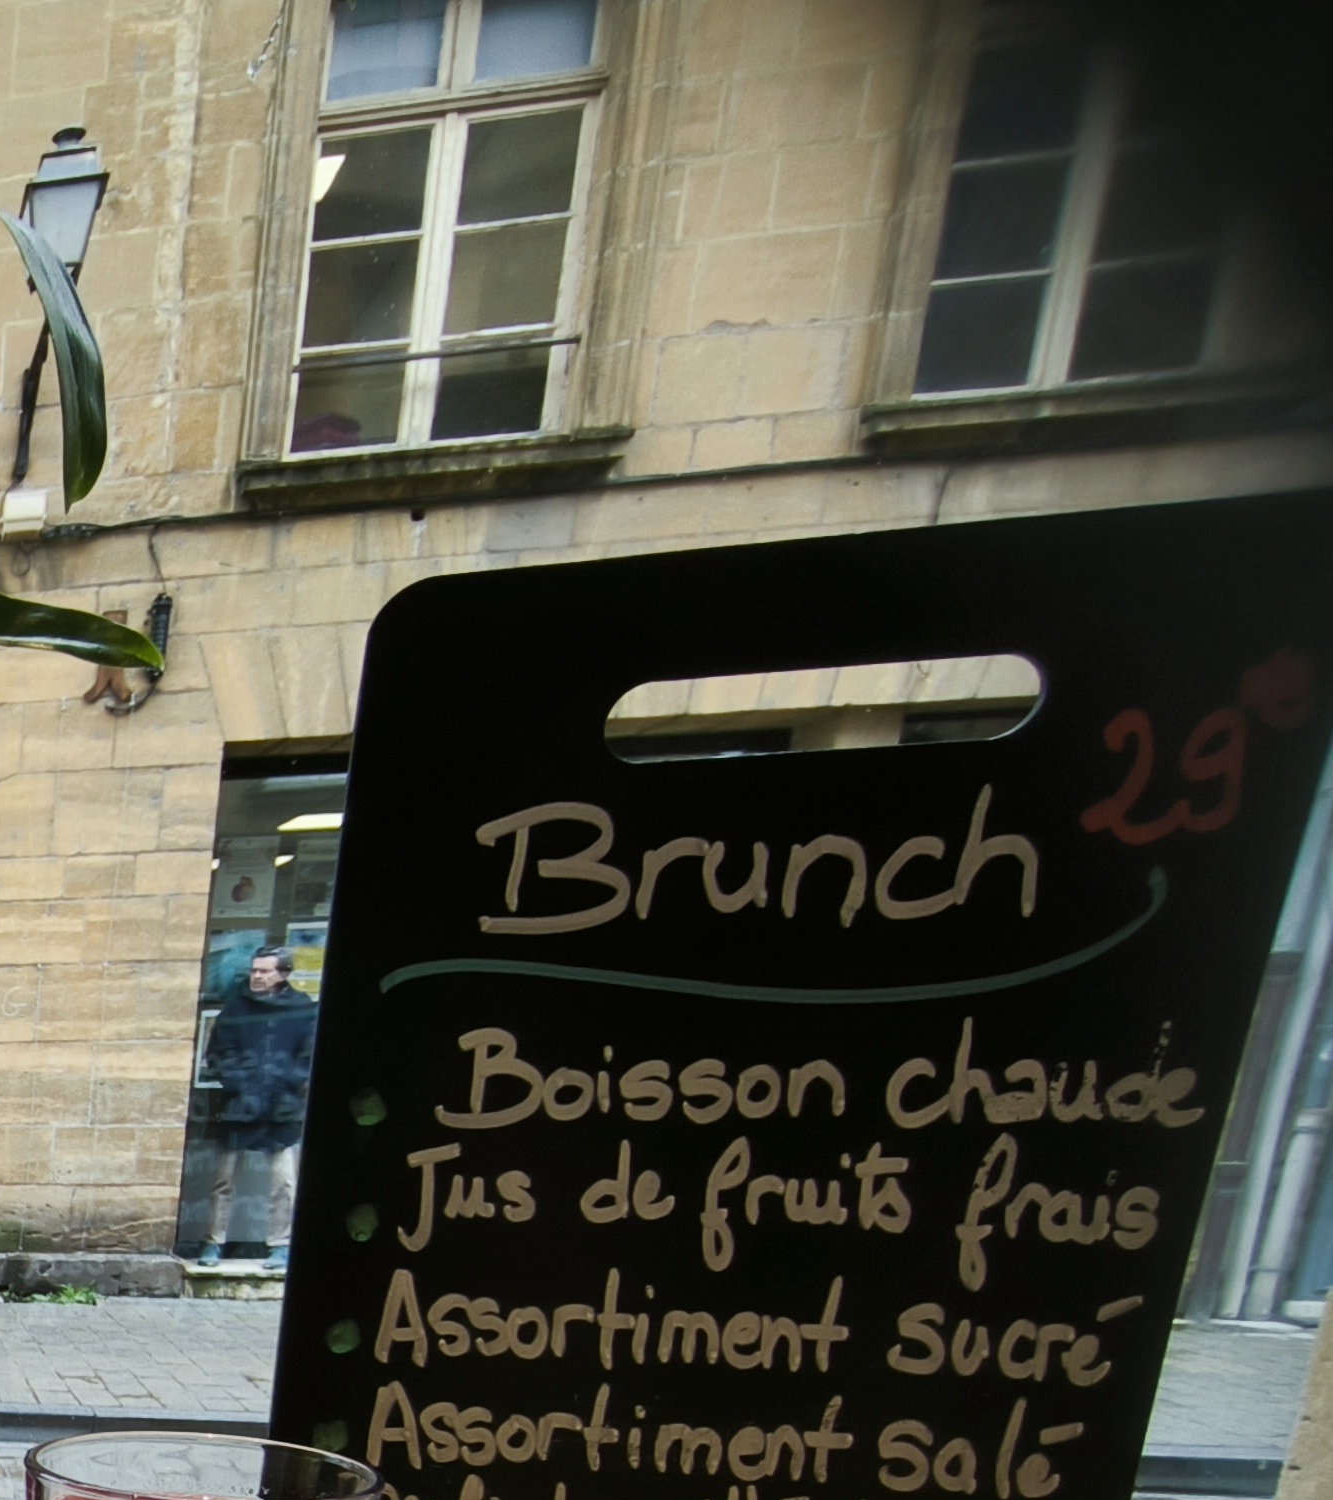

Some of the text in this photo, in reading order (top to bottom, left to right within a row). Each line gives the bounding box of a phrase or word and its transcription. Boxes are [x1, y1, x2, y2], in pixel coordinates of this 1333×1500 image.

[476, 784, 1037, 934] Brunch
[435, 1017, 1207, 1129] Boisson chaude
[396, 1132, 1160, 1292] Jus de fruits frais
[374, 1267, 850, 1373] Assortiment
[367, 1381, 853, 1483] Assortiment
